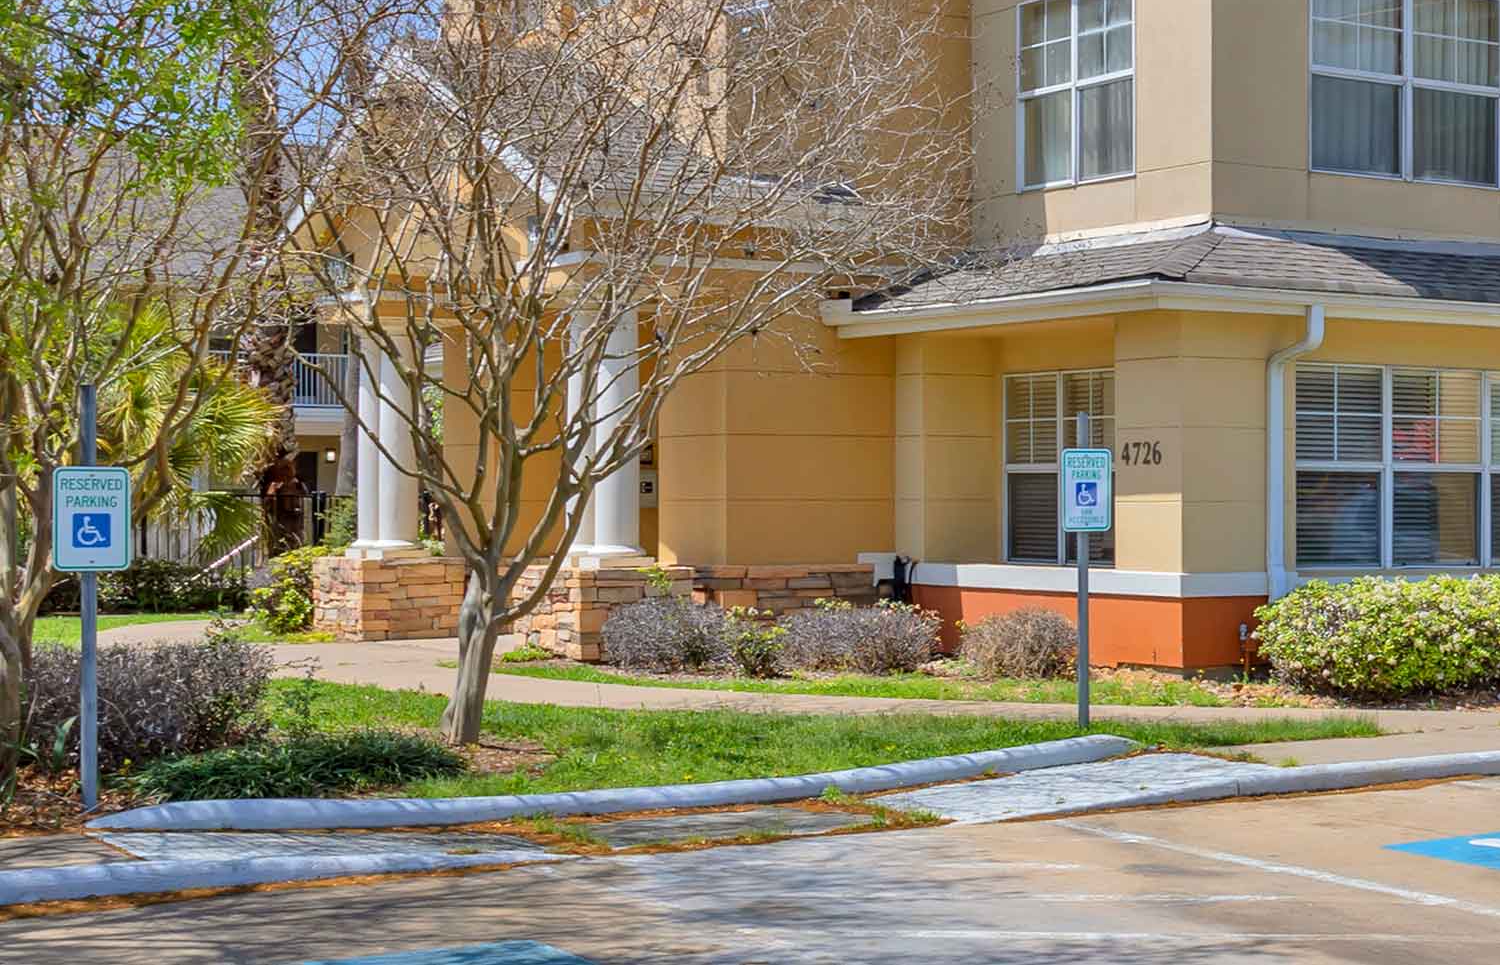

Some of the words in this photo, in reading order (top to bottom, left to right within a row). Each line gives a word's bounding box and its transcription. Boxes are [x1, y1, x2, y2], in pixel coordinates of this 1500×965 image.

[1121, 441, 1162, 466] 4726
[1067, 456, 1105, 468] RESERVED
[60, 478, 123, 490] RESERVED
[65, 496, 117, 507] PARKING
